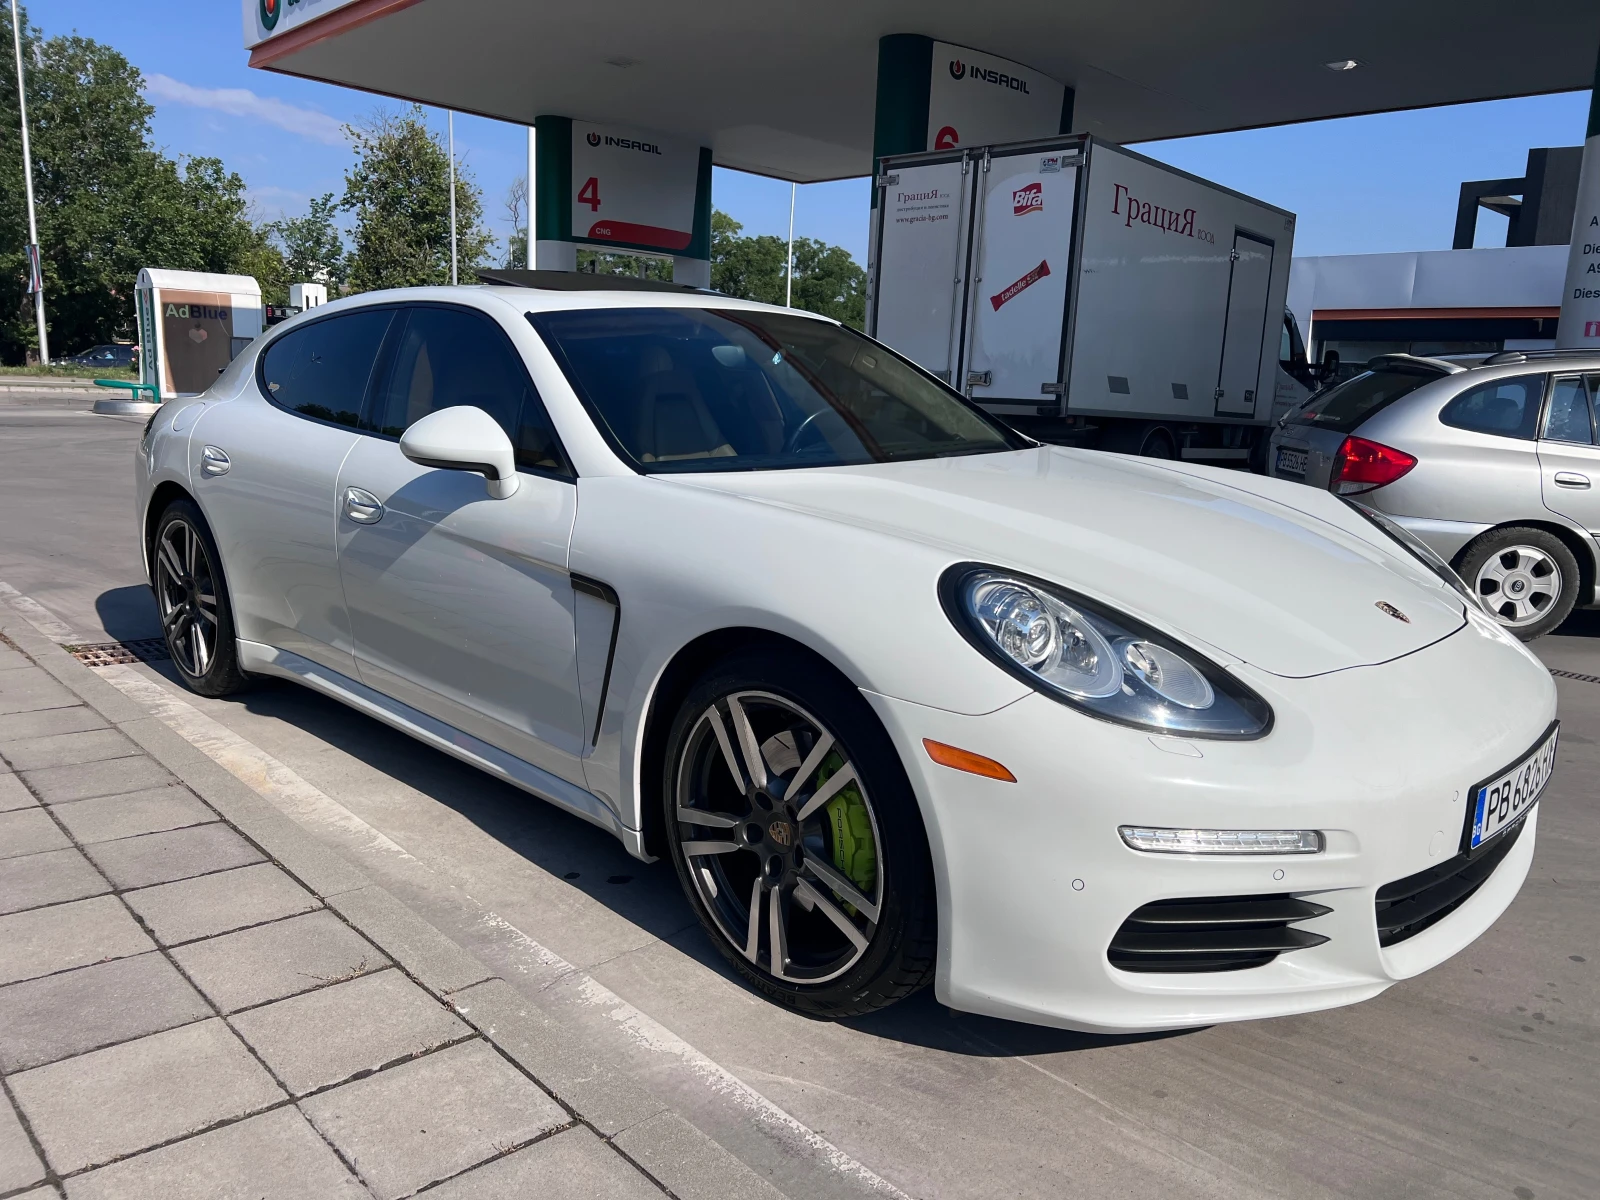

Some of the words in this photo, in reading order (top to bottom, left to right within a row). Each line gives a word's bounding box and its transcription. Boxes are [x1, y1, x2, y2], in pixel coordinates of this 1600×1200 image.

[970, 65, 1030, 95] INSAOIL
[605, 135, 662, 155] INSAOIL
[577, 176, 602, 212] 4
[897, 189, 939, 204] ГрациЯ
[1014, 188, 1043, 207] Bifa
[895, 213, 949, 224] www.gracia-bg.com
[1111, 183, 1197, 238] ГрациЯ
[595, 227, 612, 236] CNG
[1001, 279, 1027, 301] tadelle
[165, 303, 228, 320] AdBlue
[1485, 780, 1511, 832] PB
[1512, 758, 1541, 811] 6826
[836, 808, 846, 871] PORSCH
[1472, 822, 1482, 839] BG
